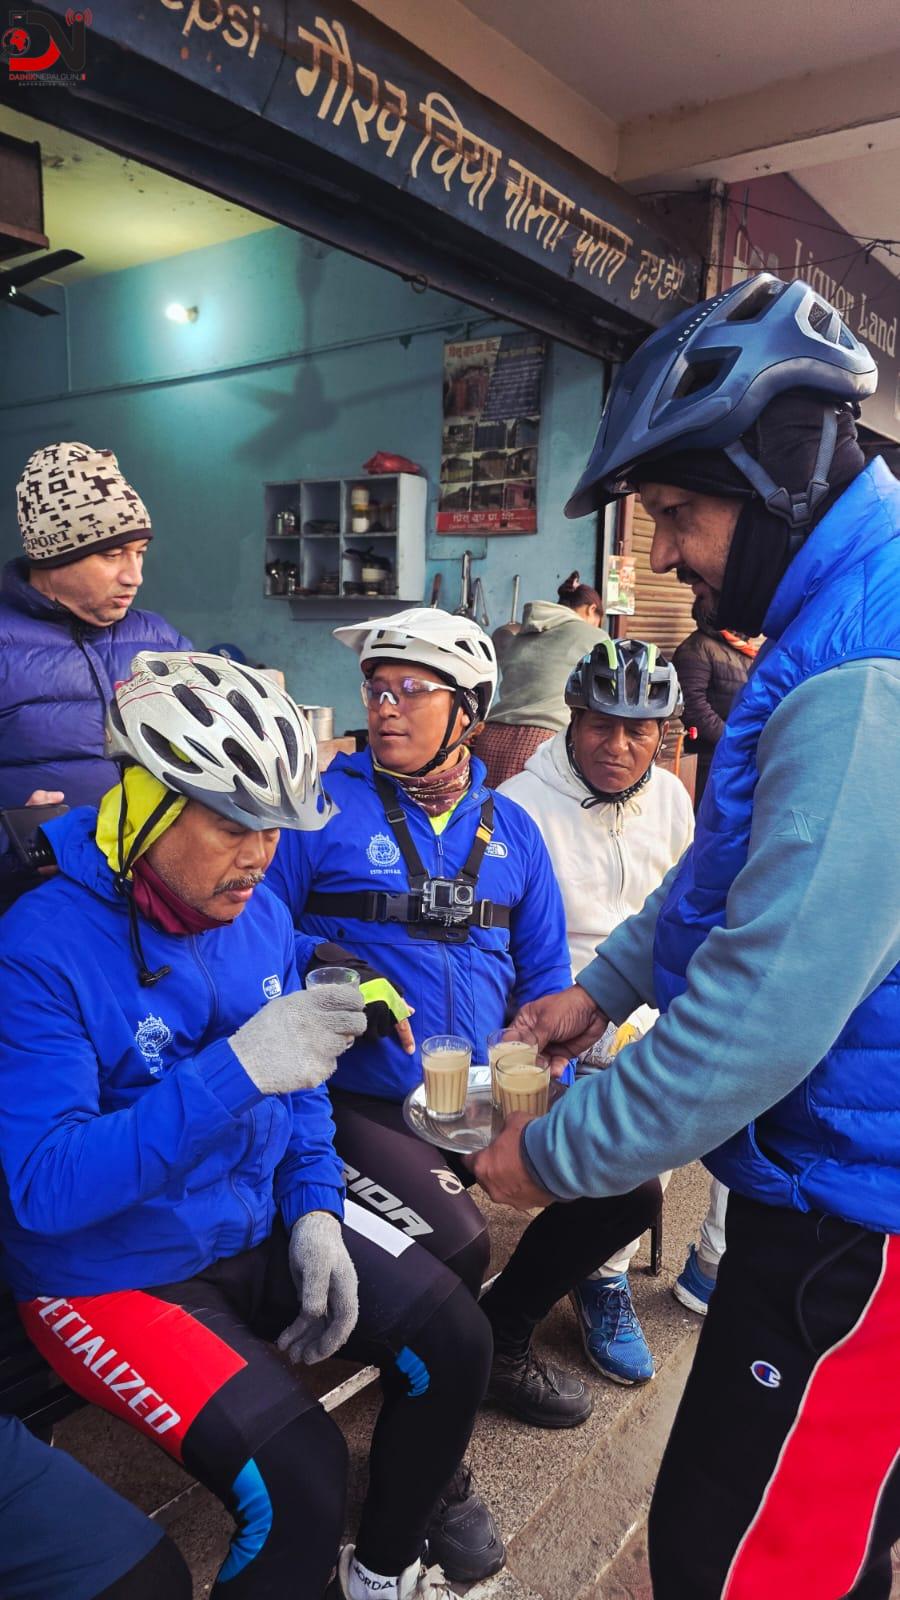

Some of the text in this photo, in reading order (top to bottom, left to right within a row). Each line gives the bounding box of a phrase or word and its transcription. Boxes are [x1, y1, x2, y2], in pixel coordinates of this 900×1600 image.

[160, 0, 262, 58] psi
[295, 16, 408, 158] गौरव
[858, 293, 898, 358] Land
[37, 1296, 182, 1435] ECIALIZED
[352, 1564, 399, 1591] JORDA
